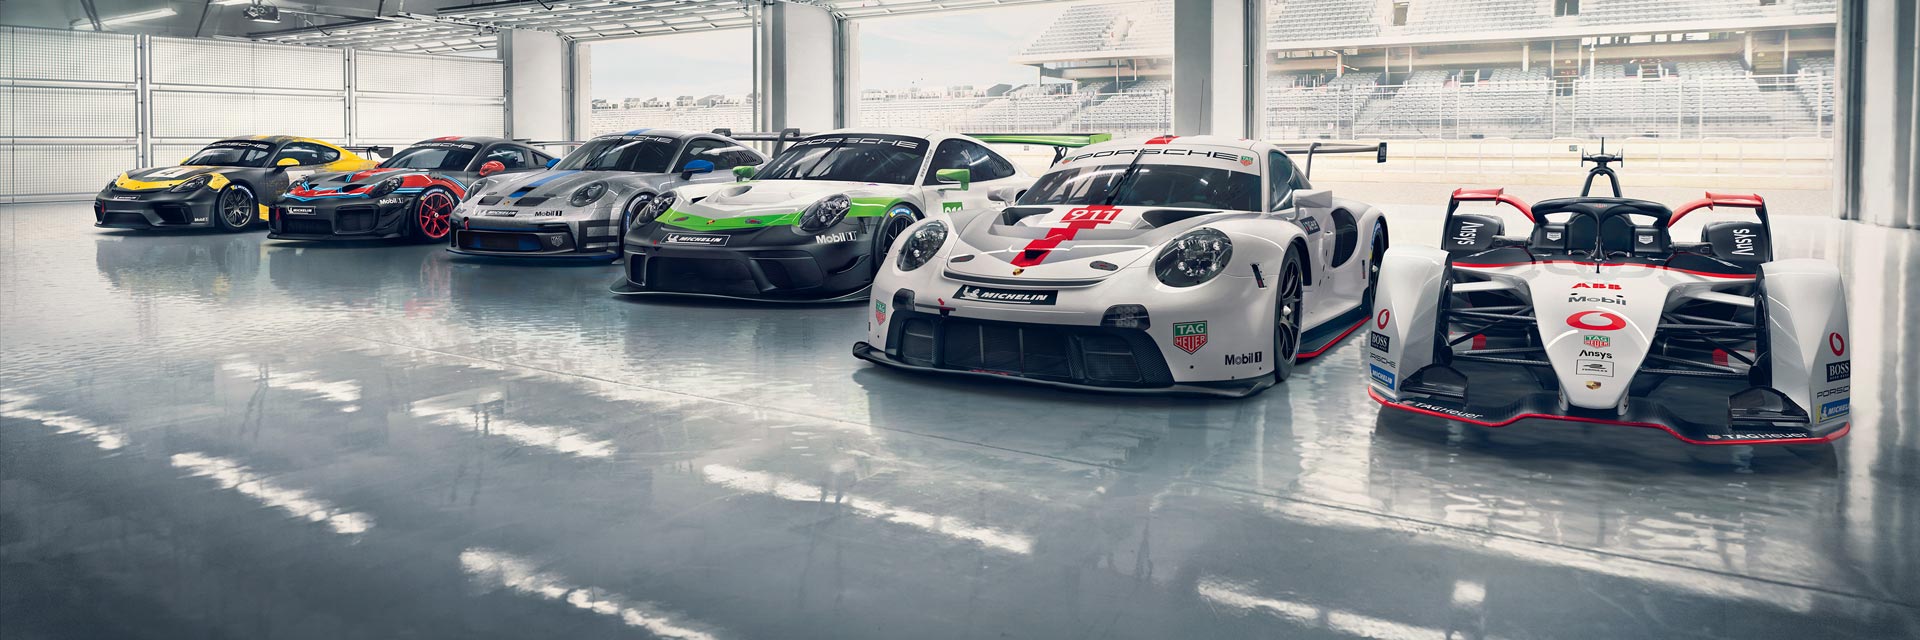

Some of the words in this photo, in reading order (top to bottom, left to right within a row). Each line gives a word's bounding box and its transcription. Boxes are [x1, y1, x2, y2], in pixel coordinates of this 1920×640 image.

[792, 138, 918, 149] PORSCHE
[1073, 149, 1238, 162] PORSCHE
[1070, 209, 1112, 221] 911
[816, 232, 846, 244] Mobil
[1453, 221, 1484, 245] Ansys
[1732, 228, 1756, 256] Ansys
[981, 292, 1048, 301] MICHELIN
[1568, 296, 1627, 305] Mobil
[1177, 324, 1205, 334] TAG
[1176, 335, 1206, 351] HEUER
[1372, 333, 1388, 347] BOSS
[1225, 353, 1254, 365] Mobil
[1369, 352, 1397, 369] RSCHE
[1579, 349, 1613, 359] Ansys
[1830, 363, 1849, 376] BOSS
[1373, 369, 1393, 384] MICHELIN
[1816, 385, 1850, 398] PORSC
